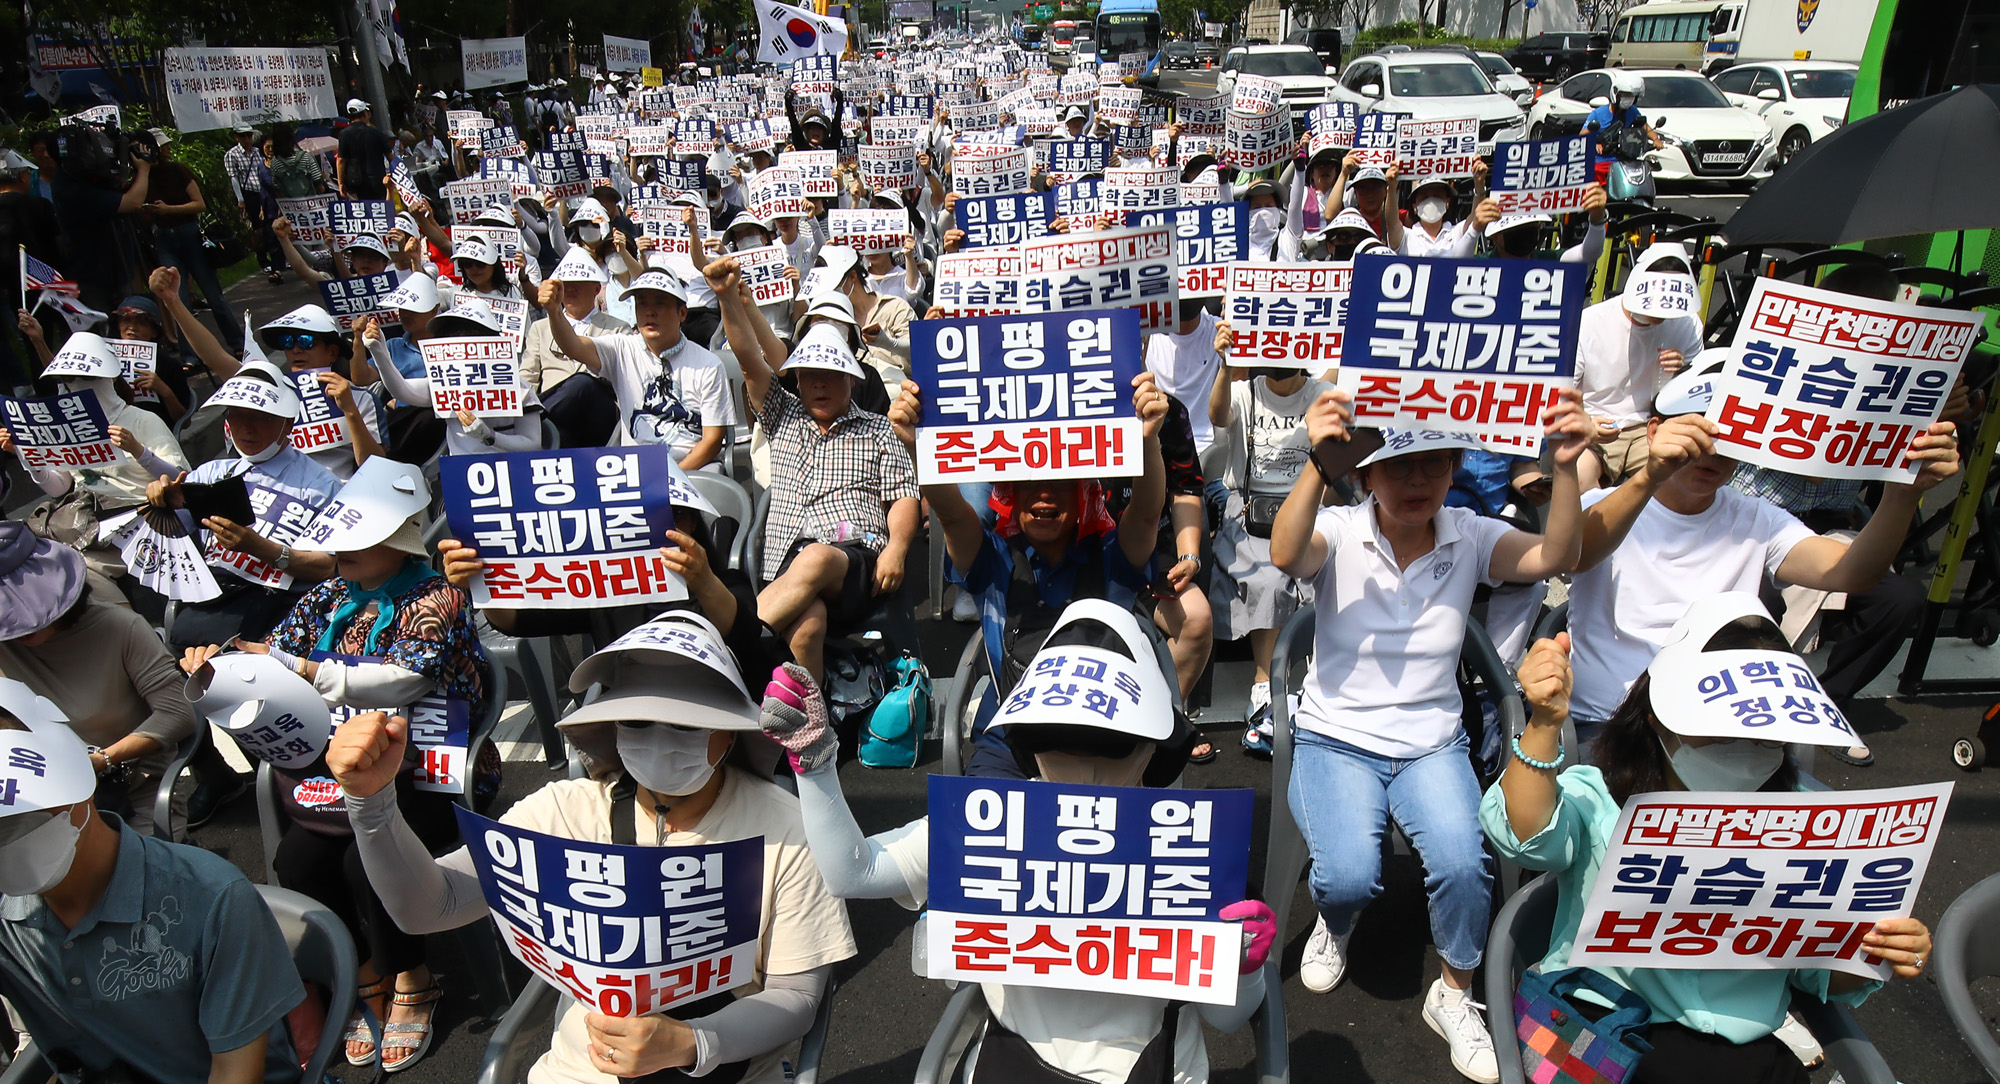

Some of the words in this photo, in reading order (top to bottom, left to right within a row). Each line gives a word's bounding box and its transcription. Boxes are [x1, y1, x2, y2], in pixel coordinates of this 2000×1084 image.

[1110, 16, 1120, 24] 406
[793, 69, 833, 81] 국제기준
[1102, 98, 1138, 108] 학습권을
[1238, 87, 1279, 104] 학습권을
[954, 113, 998, 128] 학습권을
[1311, 118, 1355, 134] 국제기준
[483, 136, 518, 150] 국제기준
[677, 132, 711, 141] 국제기준
[732, 129, 768, 143] 국제기준
[1118, 135, 1152, 147] 국제기준
[1228, 122, 1291, 150] 학습권을
[1400, 137, 1475, 156] 학습권을
[677, 143, 713, 152] 준수하라!
[1227, 142, 1292, 167] 보장하라!
[862, 159, 913, 175] 학습권을
[1056, 158, 1102, 172] 국제기준
[658, 172, 700, 189] 국제기준
[956, 170, 1027, 195] 학습권을
[1504, 161, 1586, 191] 국제기준
[453, 193, 512, 209] 학습권을
[751, 183, 801, 204] 학습권을
[1106, 187, 1178, 208] 학습권을
[334, 219, 388, 233] 국제기준
[833, 219, 904, 232] 학습권을
[1026, 264, 1170, 311] 학습권을
[1370, 318, 1560, 373] 국제기준
[430, 363, 514, 386] 학습권을
[1737, 340, 1948, 417] 학습권을
[436, 390, 516, 411] 보장하라!
[936, 371, 1117, 422] 국제기준
[13, 418, 100, 445] 국제기준
[22, 444, 116, 467] 준수하라!
[934, 425, 1123, 474] 준수하라!
[473, 506, 651, 554] 국제기준
[483, 556, 667, 599] 준수하라!
[1012, 656, 1142, 704] 학교육
[1006, 683, 1119, 720] 정상화
[301, 780, 340, 794] SWEET
[295, 792, 340, 804] DREAMS
[960, 855, 1212, 916] 국제기준
[1613, 854, 1914, 912] 학습권을
[498, 880, 728, 963] 국제기준
[952, 920, 1216, 987] 준수하라!
[510, 924, 732, 1018] 준수하라!
